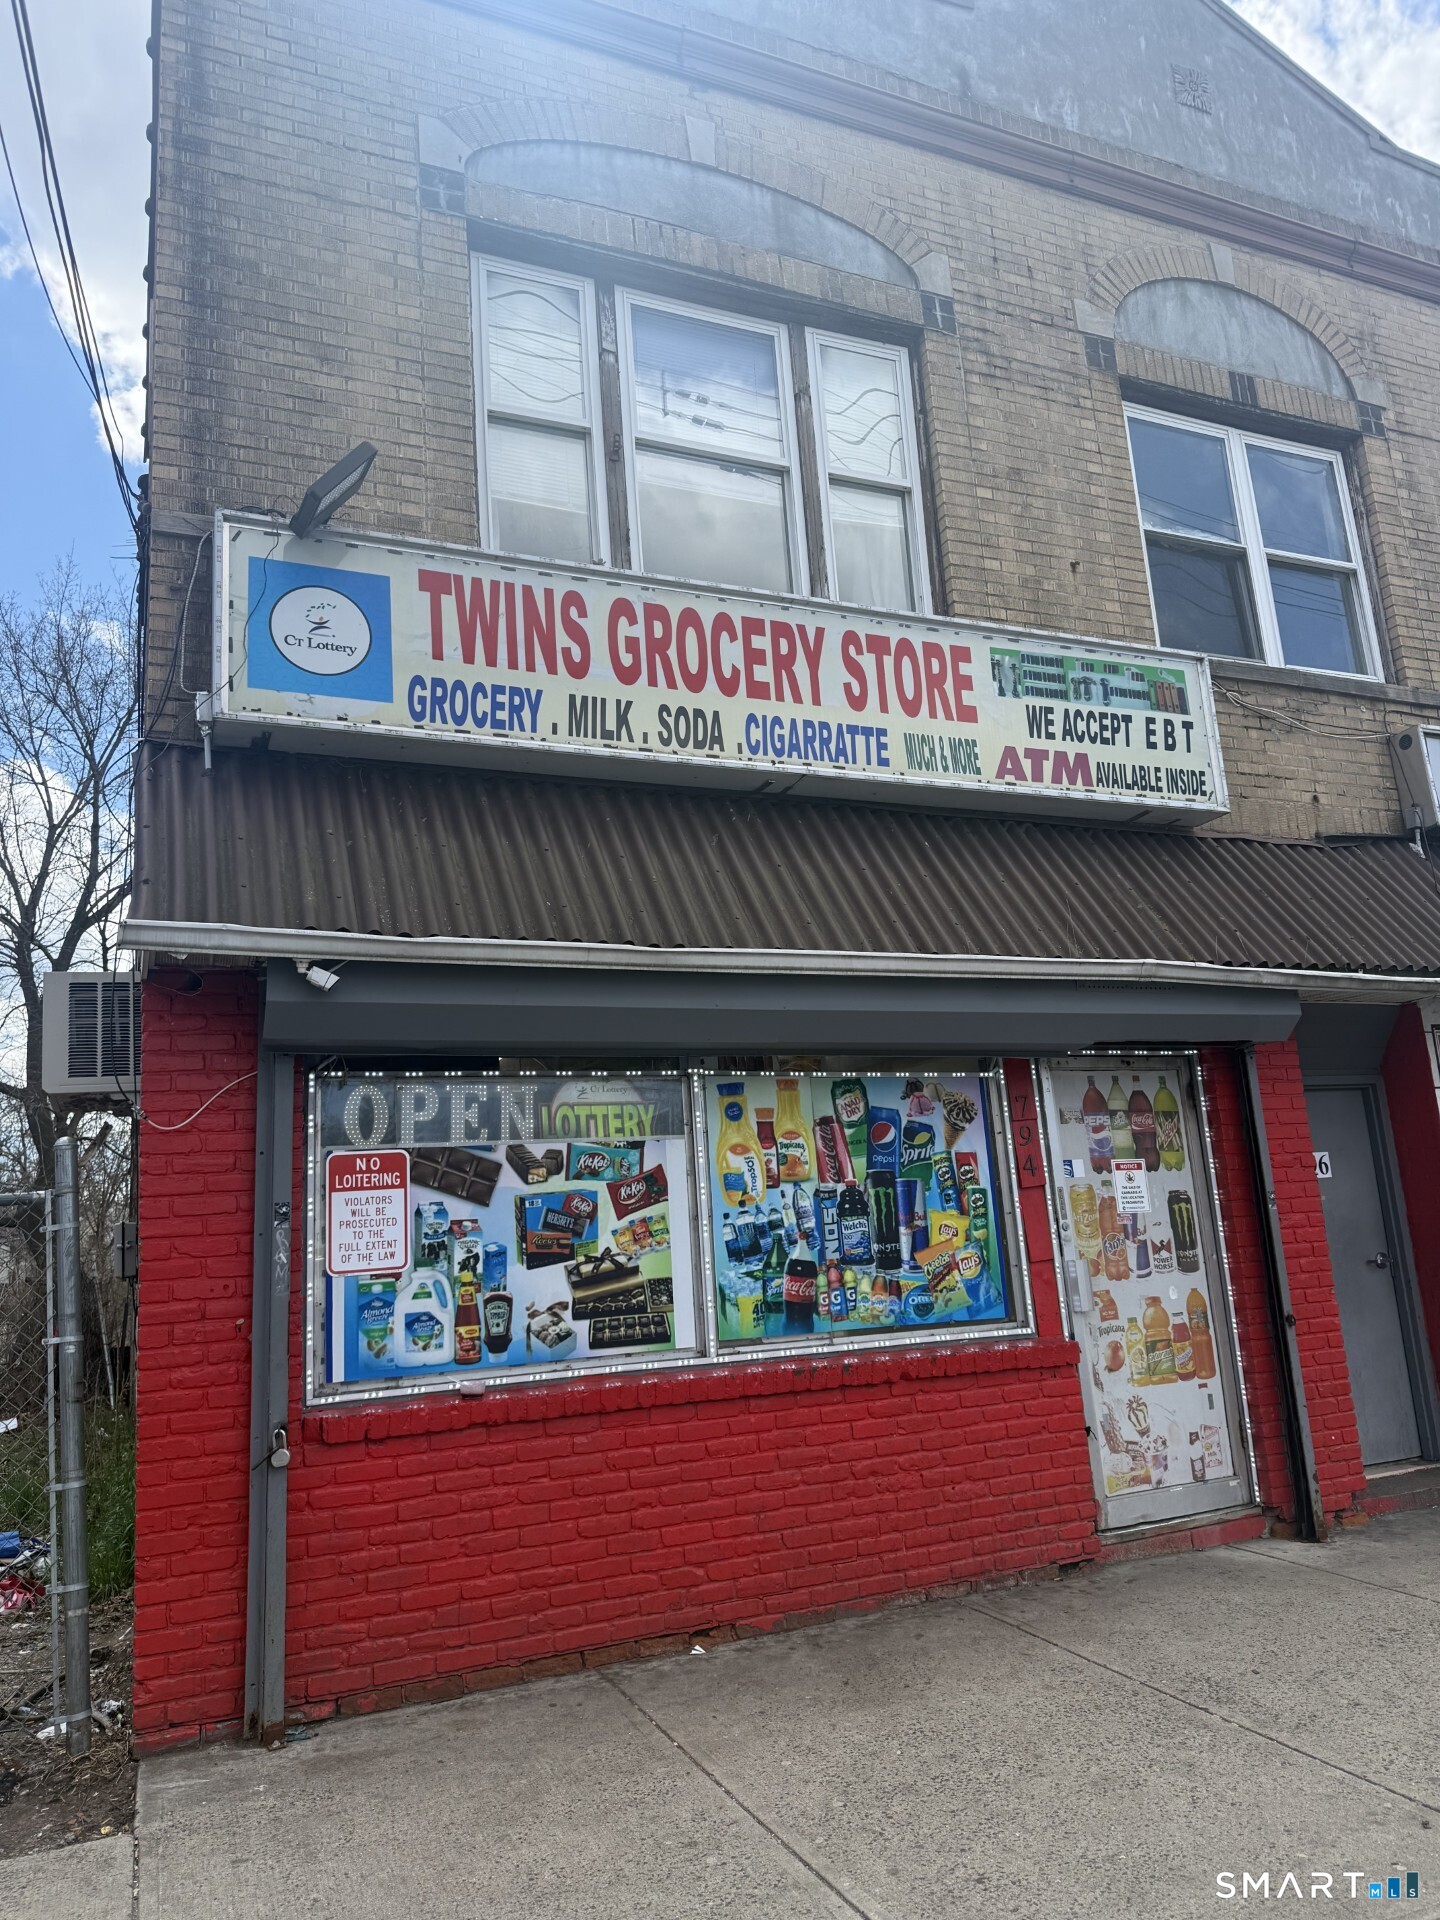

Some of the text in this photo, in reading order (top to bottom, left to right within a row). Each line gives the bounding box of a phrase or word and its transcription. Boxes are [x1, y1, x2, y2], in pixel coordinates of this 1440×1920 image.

[307, 637, 358, 656] Lottery
[418, 568, 979, 724] TWINS GROCERY STORE
[407, 674, 543, 734] GROCERY
[568, 694, 634, 743] MILK
[658, 703, 725, 752] SODA
[1025, 704, 1056, 741] WE
[1062, 708, 1133, 748] ACCEPT
[904, 732, 982, 776] MUCH & MORE
[995, 746, 1208, 797] ATM AVAILABLE INSIDE
[344, 1084, 538, 1148] OPEN
[540, 1104, 655, 1138] LOTTERY
[778, 1141, 804, 1150] Tropicana
[356, 1157, 380, 1171] NO
[872, 1154, 894, 1164] pepsi
[336, 1172, 400, 1188] LOITERING
[344, 1196, 393, 1206] VIOLATORS
[350, 1206, 386, 1218] WILL BE
[339, 1217, 398, 1230] PROSECUTED
[842, 1221, 868, 1232] Welch's
[352, 1229, 384, 1240] TO THE
[339, 1240, 398, 1252] FULL EXTENT
[340, 1250, 396, 1264] OF THE LAW
[924, 1250, 950, 1278] Cheetos
[832, 1290, 840, 1304] G
[1097, 1323, 1126, 1338] Tropicana
